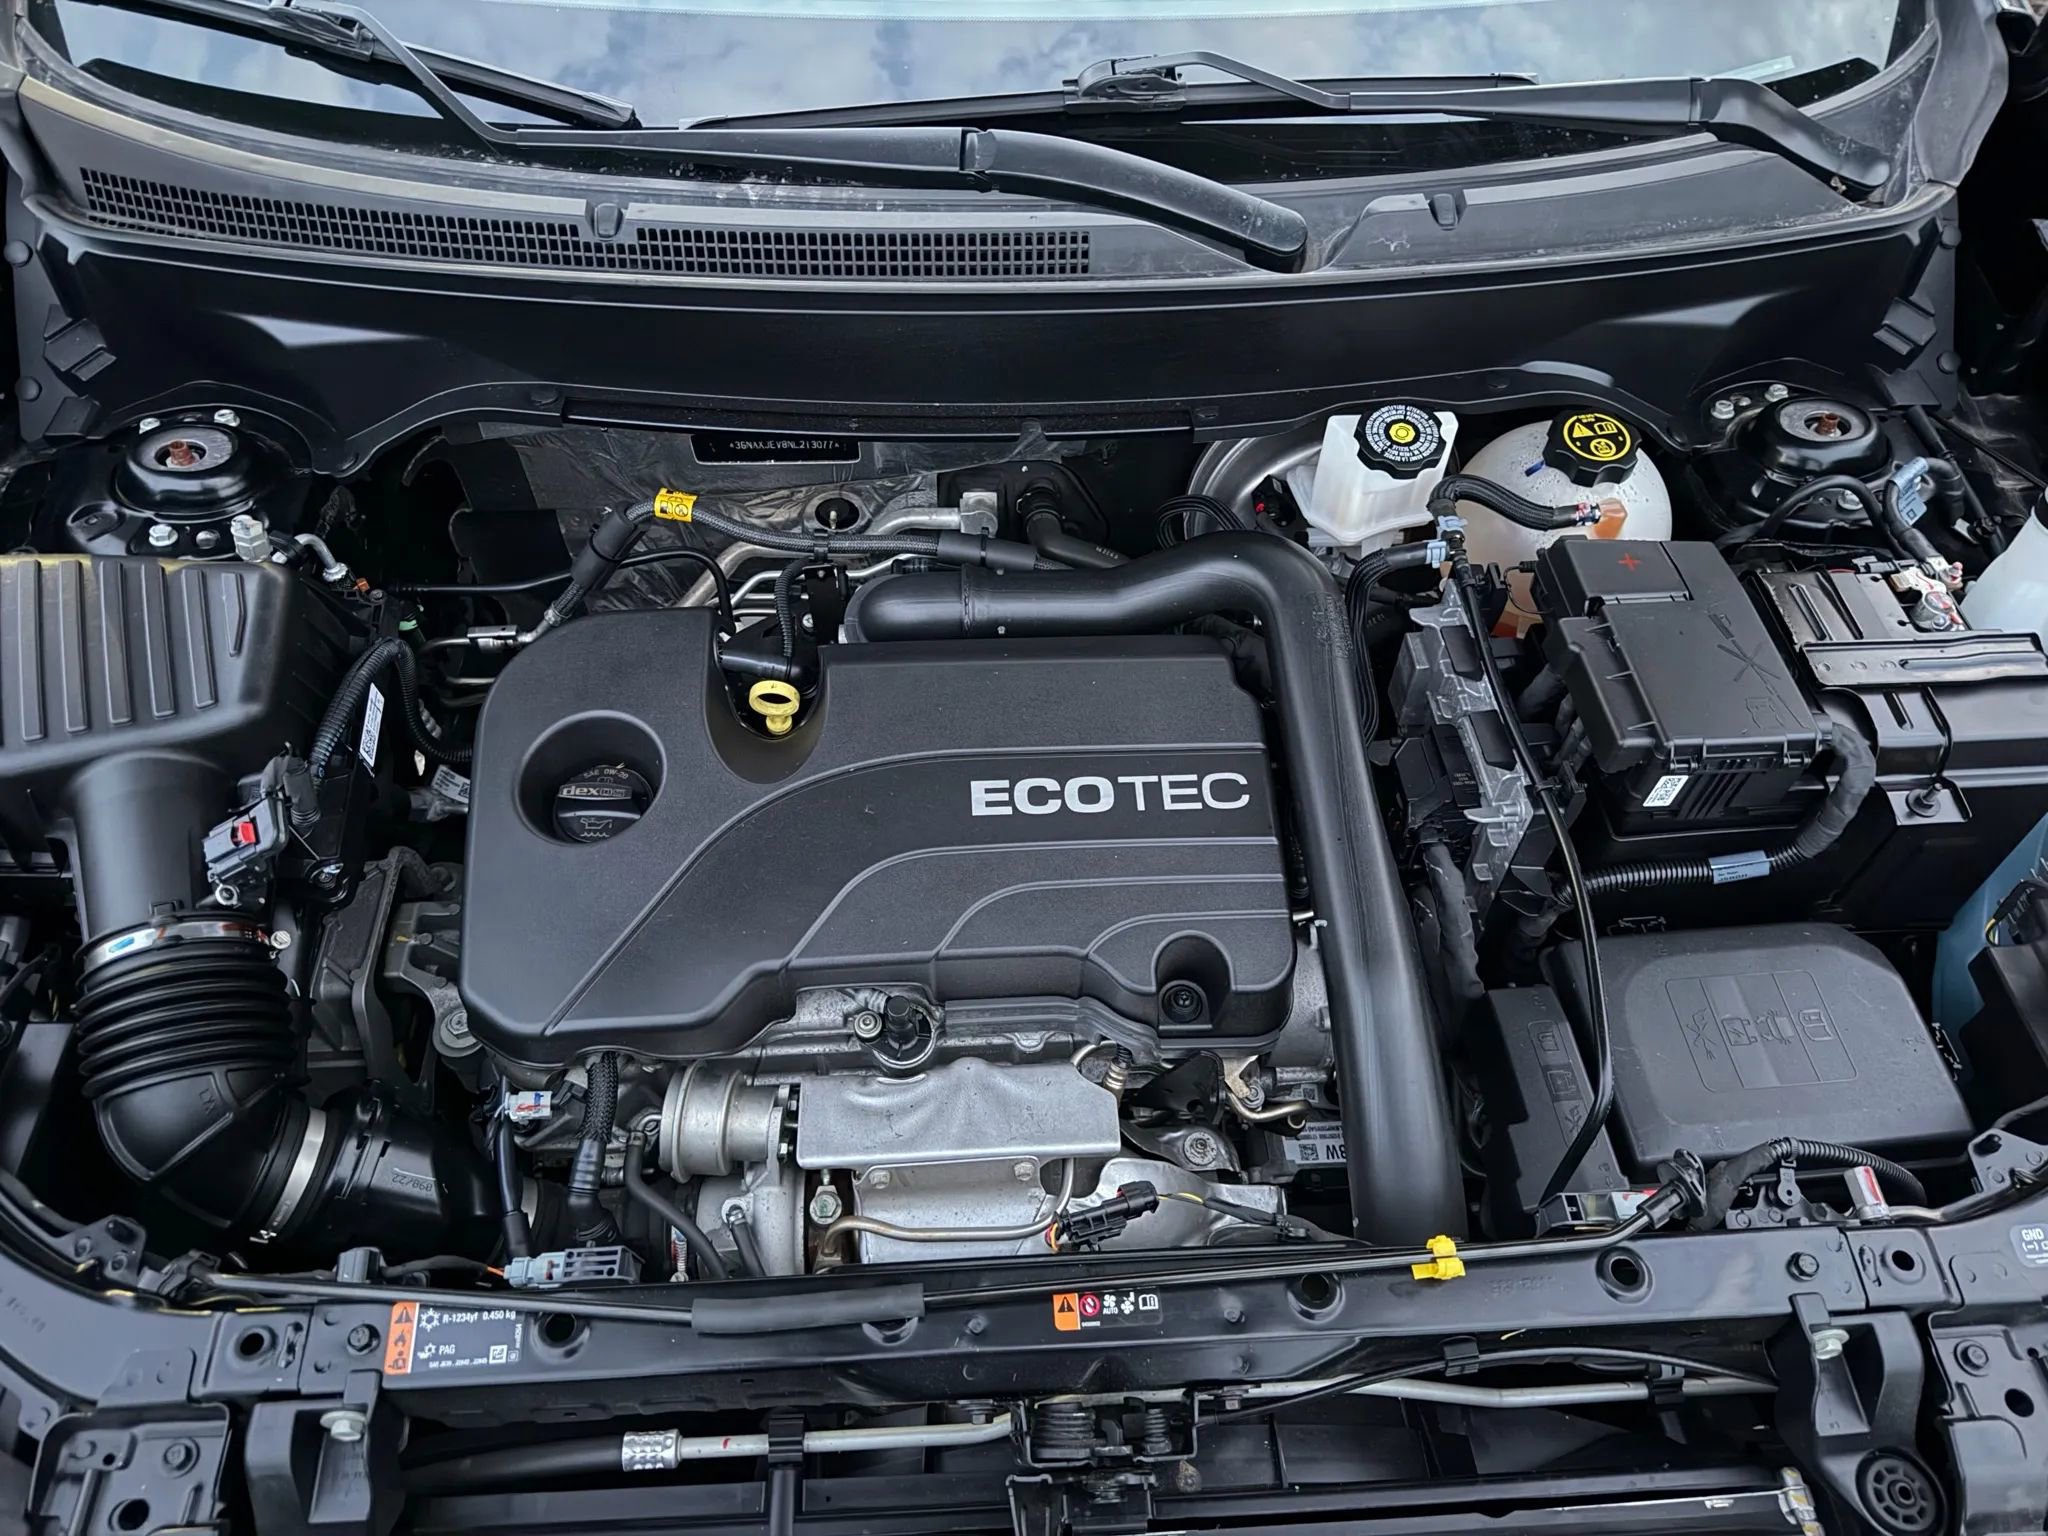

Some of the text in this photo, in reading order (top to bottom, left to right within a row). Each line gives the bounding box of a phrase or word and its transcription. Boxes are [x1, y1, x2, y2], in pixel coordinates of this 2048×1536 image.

[970, 772, 1250, 816] ECOTEC
[2022, 1228, 2044, 1241] GND
[442, 1310, 516, 1324] R-1234yf 0.450 kg
[1103, 1307, 1118, 1315] AUTO
[439, 1344, 456, 1355] PAG
